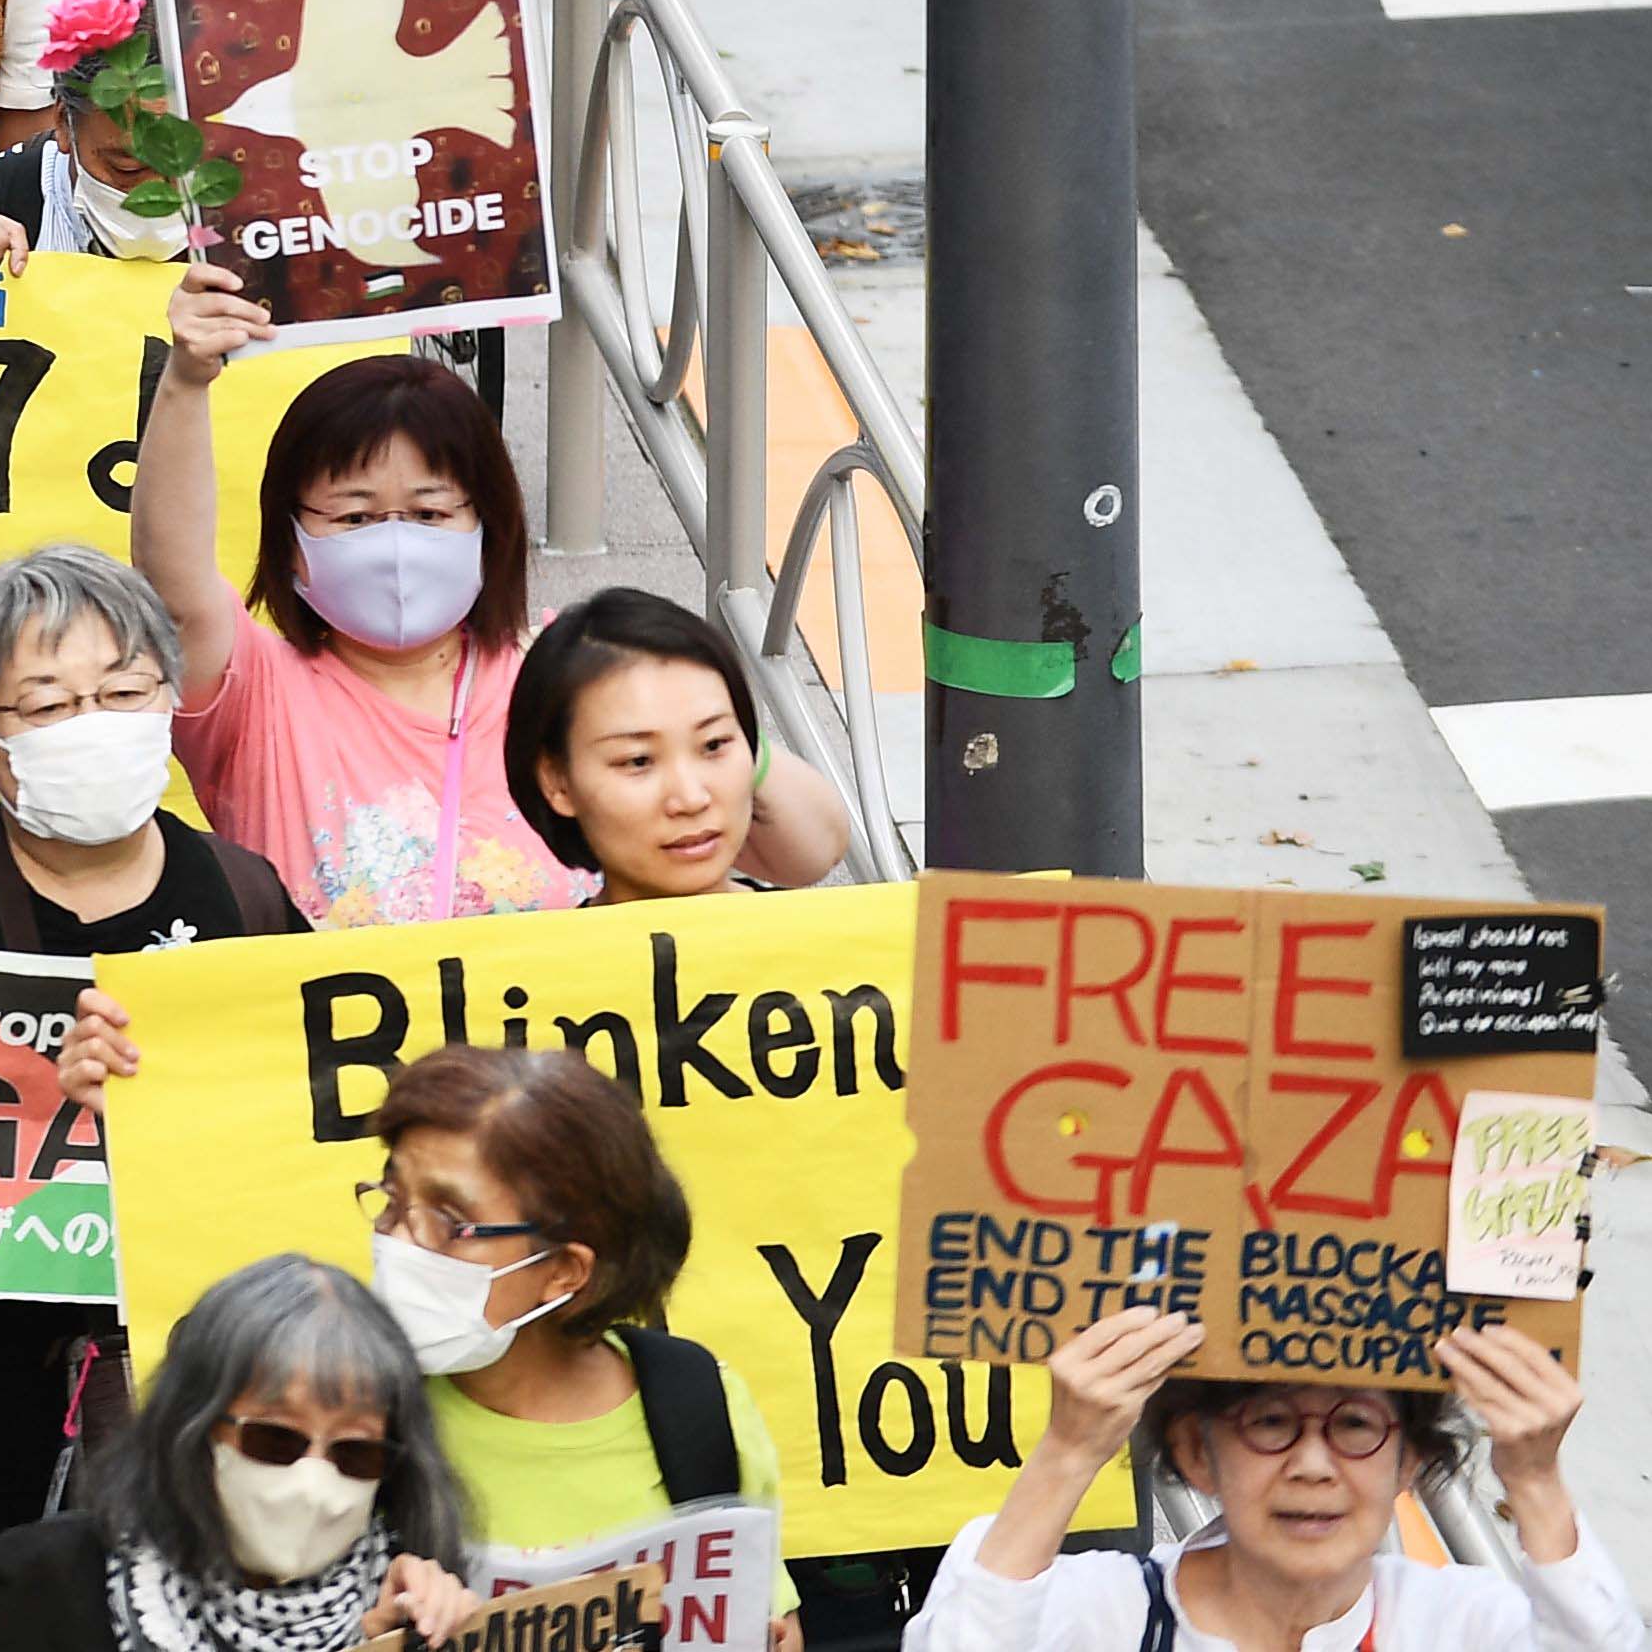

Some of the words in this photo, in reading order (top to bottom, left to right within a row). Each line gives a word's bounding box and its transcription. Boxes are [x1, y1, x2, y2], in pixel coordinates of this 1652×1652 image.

[297, 137, 435, 189] STOP
[241, 192, 507, 261] GENOCIDE
[940, 896, 1376, 1061] FREE
[981, 1059, 1459, 1230] GAZA
[929, 1212, 1073, 1267] END
[1085, 1226, 1213, 1283] THE
[1241, 1230, 1448, 1293] BLOCKA
[925, 1265, 1067, 1318] END
[1240, 1284, 1509, 1338] MASSACRE
[925, 1312, 1056, 1362] END
[756, 1231, 1024, 1488] You
